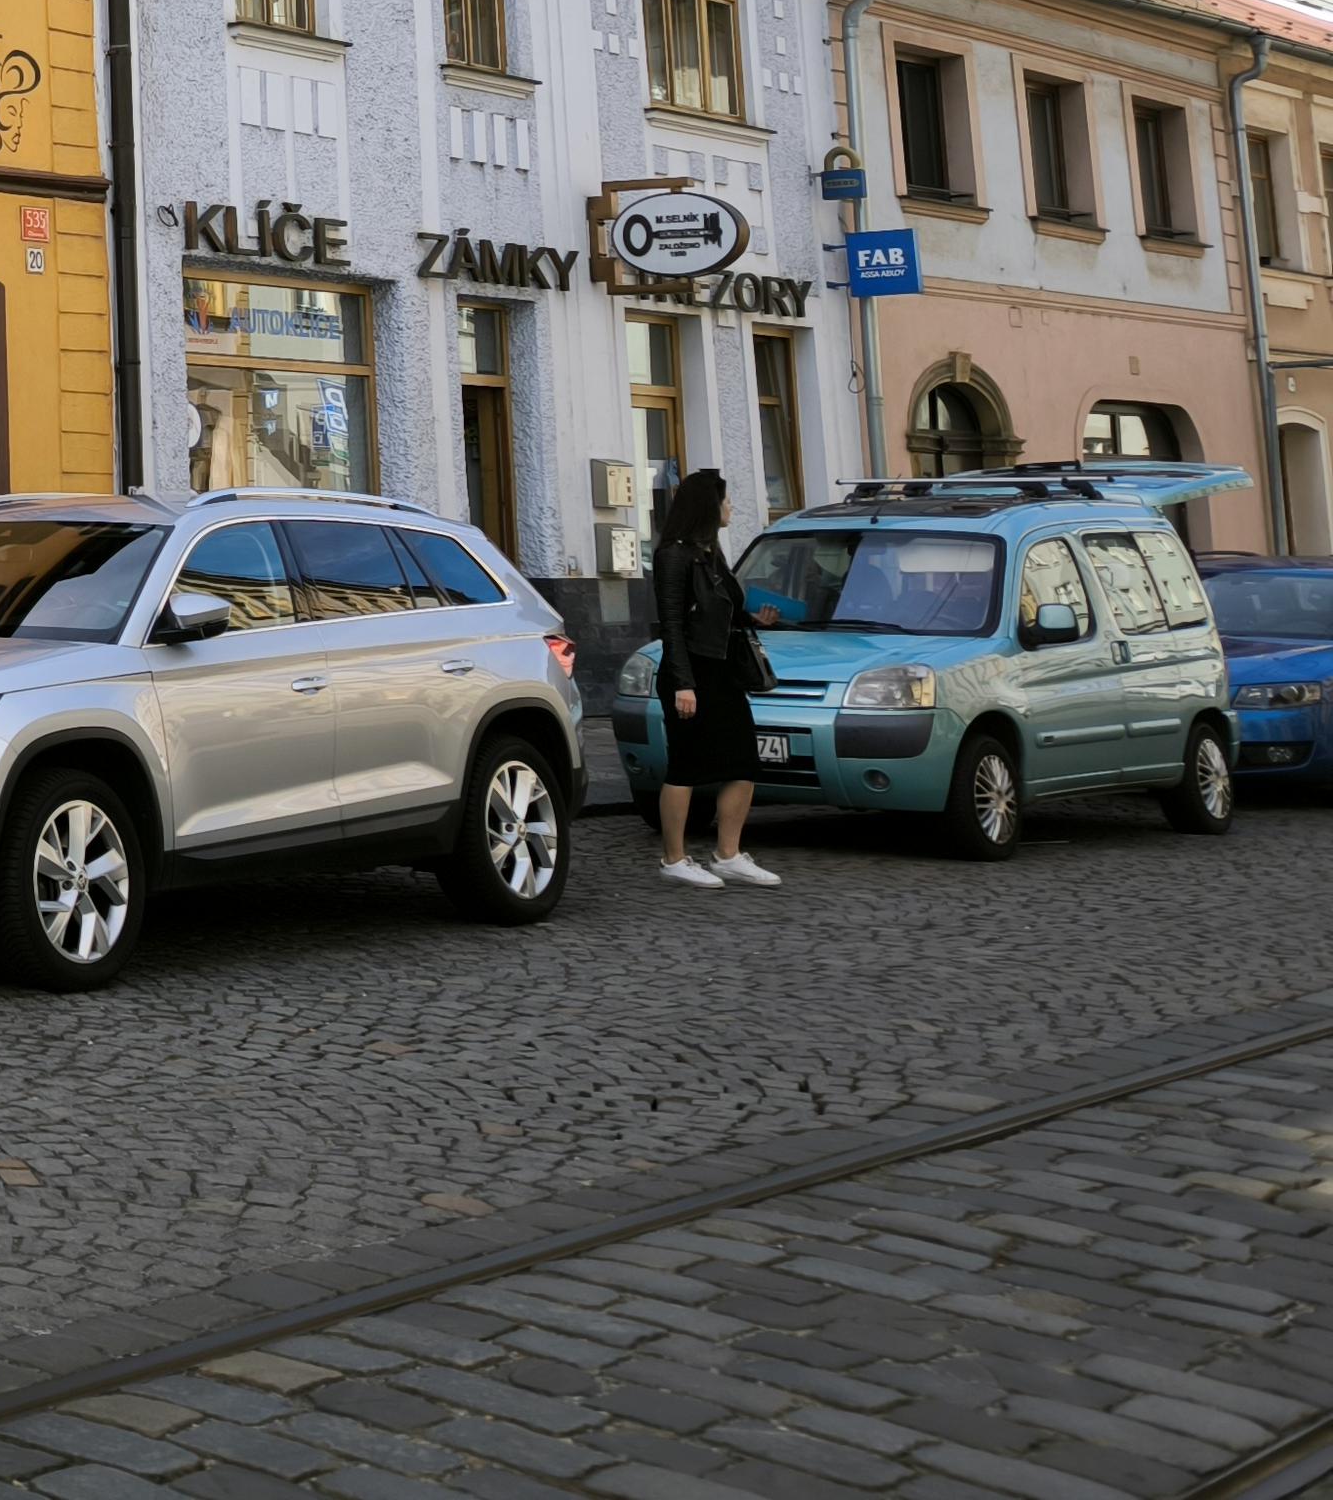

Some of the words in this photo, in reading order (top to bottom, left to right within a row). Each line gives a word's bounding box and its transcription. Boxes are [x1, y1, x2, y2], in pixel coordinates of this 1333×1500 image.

[25, 210, 46, 228] 535
[185, 200, 351, 267] KLÍČE
[29, 251, 42, 269] 20
[417, 227, 580, 291] ZÁMKY
[857, 248, 905, 268] FAB
[860, 270, 880, 279] ASSA
